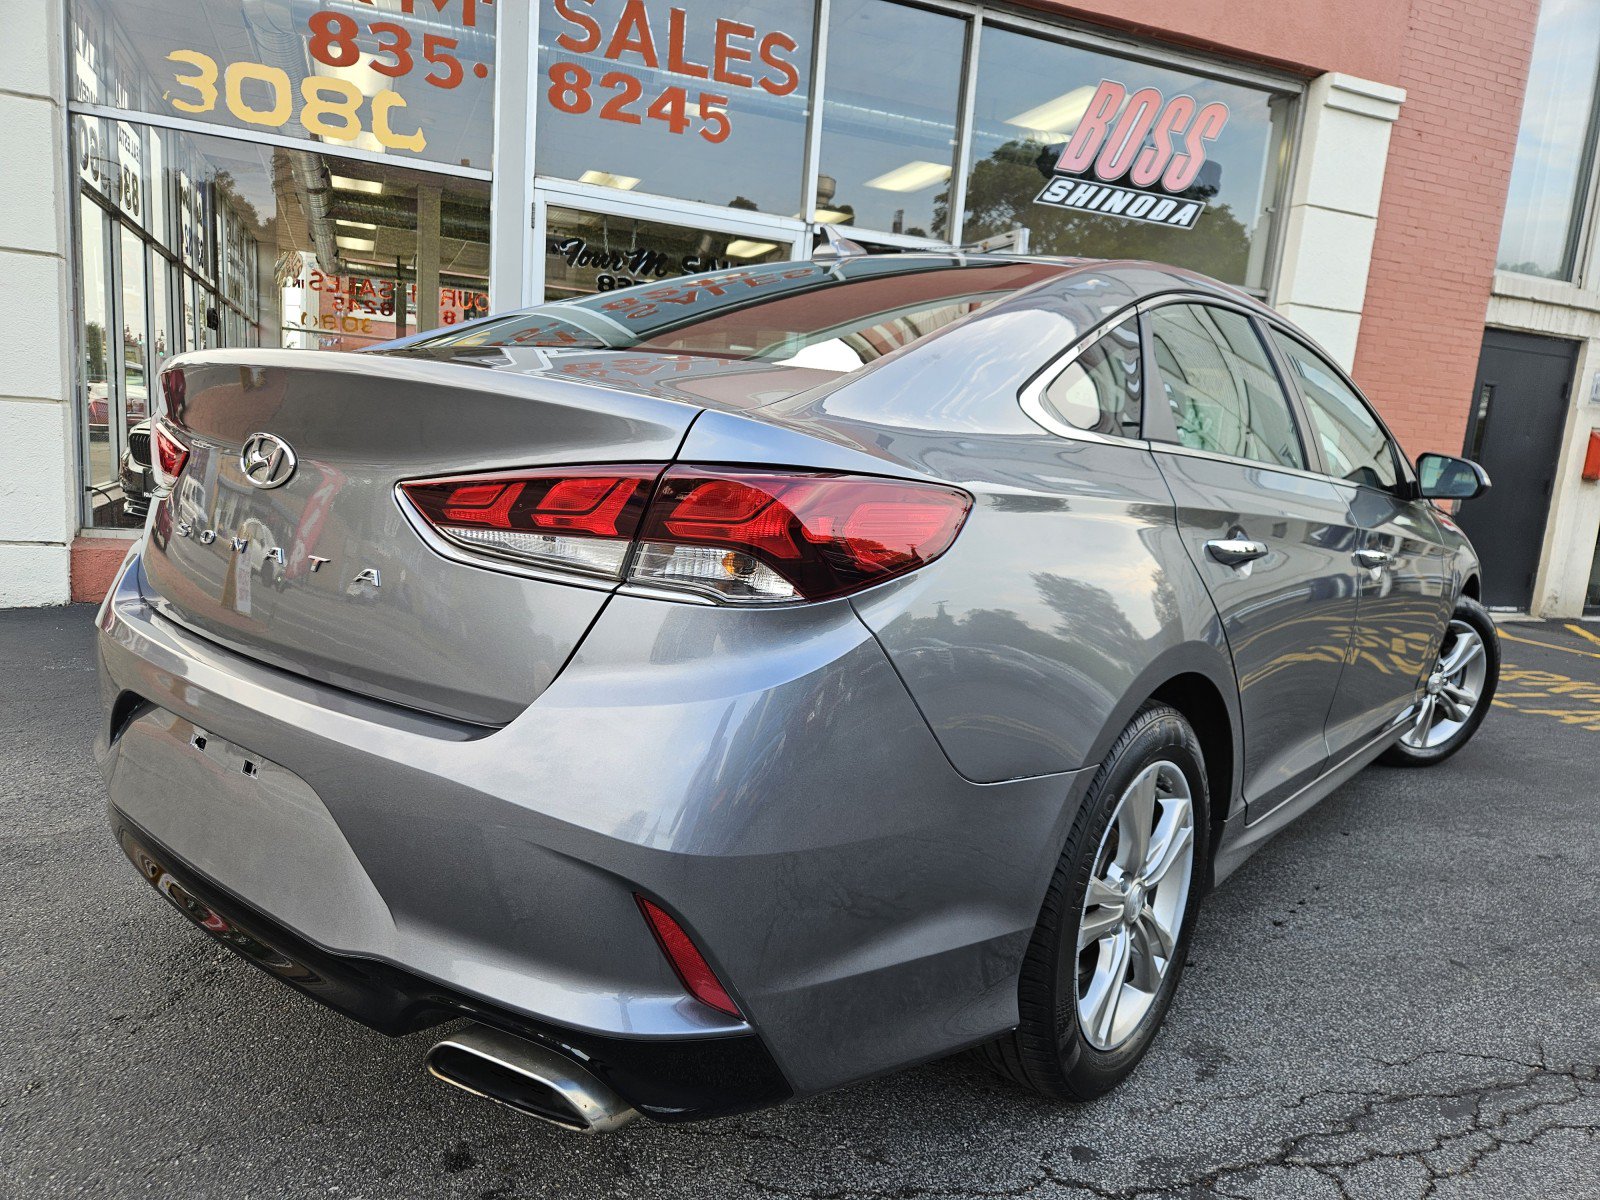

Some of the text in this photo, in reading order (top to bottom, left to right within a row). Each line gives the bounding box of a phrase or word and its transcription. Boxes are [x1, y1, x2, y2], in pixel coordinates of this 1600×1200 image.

[555, 0, 800, 97] SALES
[547, 62, 732, 144] 8245
[1054, 78, 1231, 194] BOSS
[1041, 180, 1200, 227] SHINODA
[176, 522, 383, 588] SONATA
